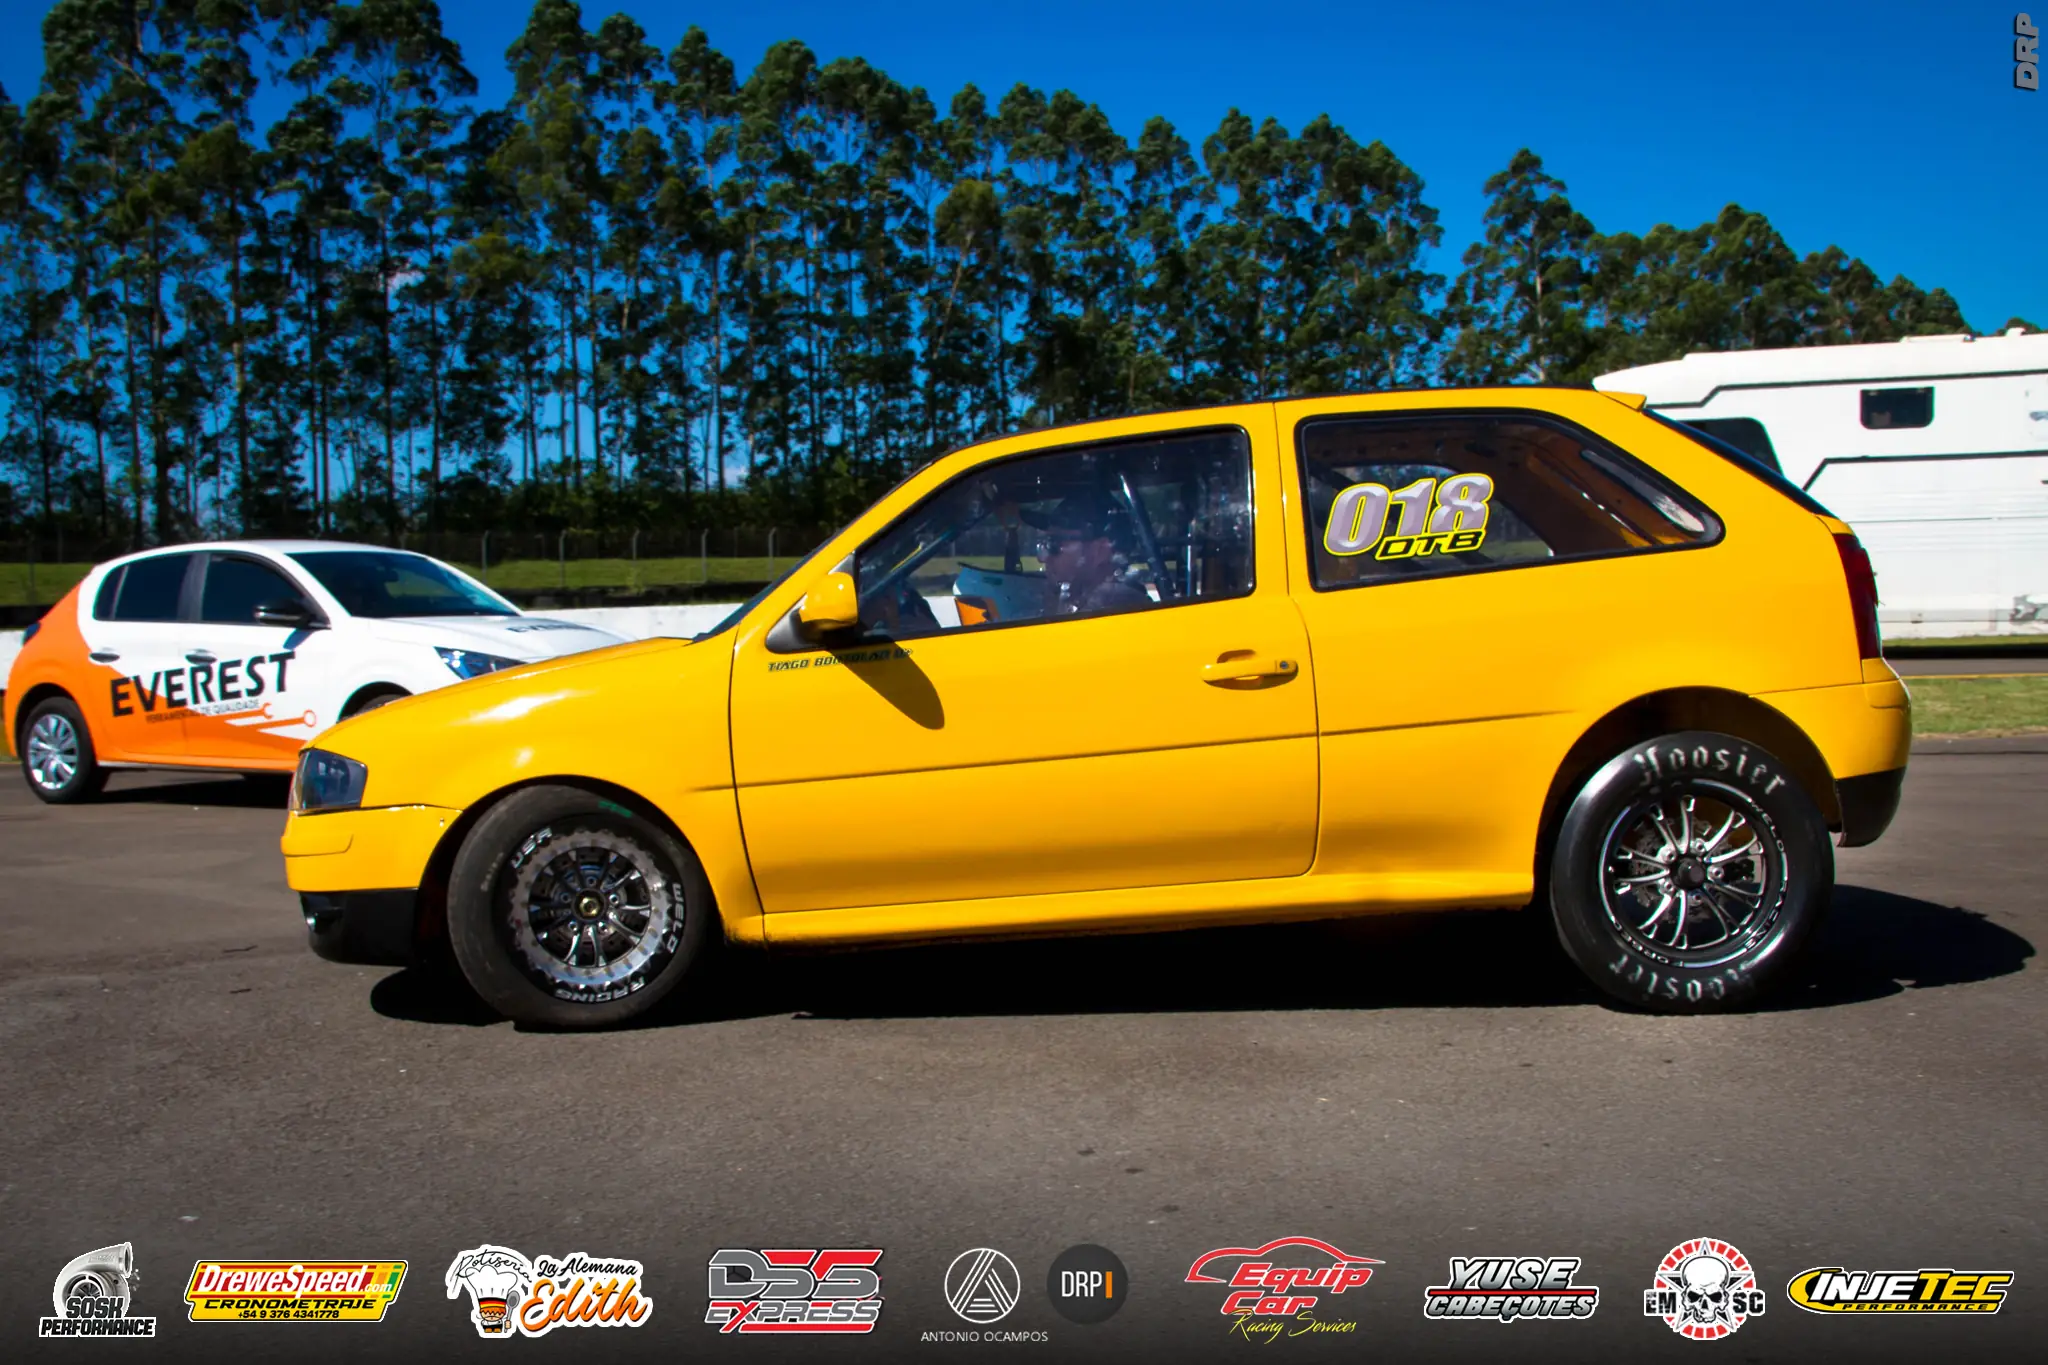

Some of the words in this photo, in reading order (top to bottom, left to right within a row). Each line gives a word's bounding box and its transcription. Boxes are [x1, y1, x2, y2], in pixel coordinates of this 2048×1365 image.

[1324, 473, 1494, 555] 018
[1376, 528, 1486, 560] DTB
[110, 651, 295, 717] EVEREST
[768, 659, 809, 672] TIAGO
[1633, 746, 1786, 795] Hoosier
[511, 828, 552, 868] USA
[666, 883, 685, 953] WELD
[555, 978, 646, 1002] RACING
